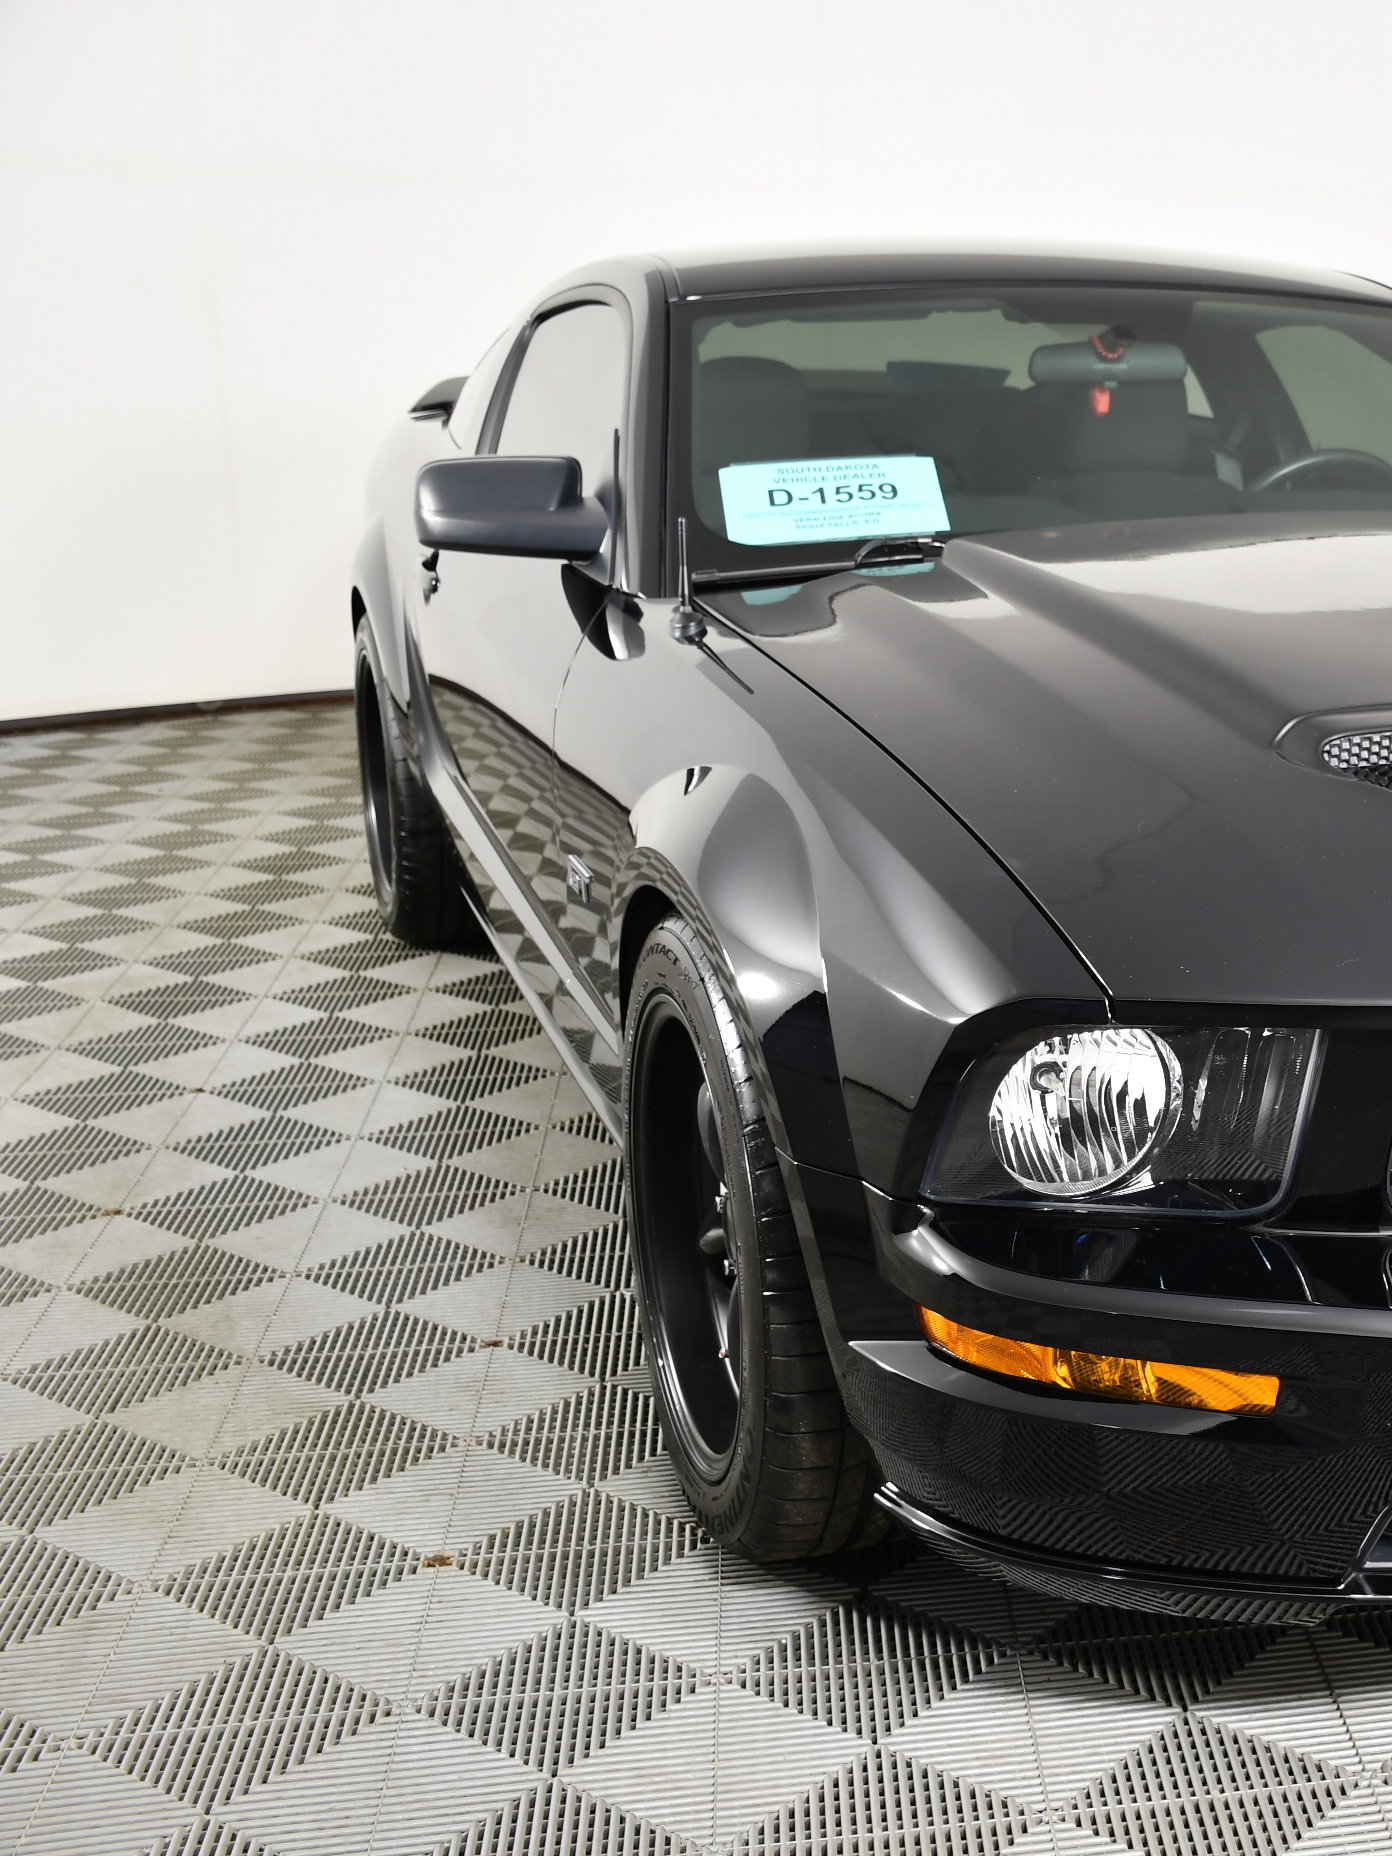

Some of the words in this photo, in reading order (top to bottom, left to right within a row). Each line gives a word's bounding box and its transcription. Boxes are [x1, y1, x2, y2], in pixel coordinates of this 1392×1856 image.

[776, 466, 822, 475] SOUTH
[826, 463, 880, 473] DAKOTA
[773, 475, 829, 484] VEHICLE
[833, 472, 887, 482] DEALER
[768, 482, 899, 507] D-1559
